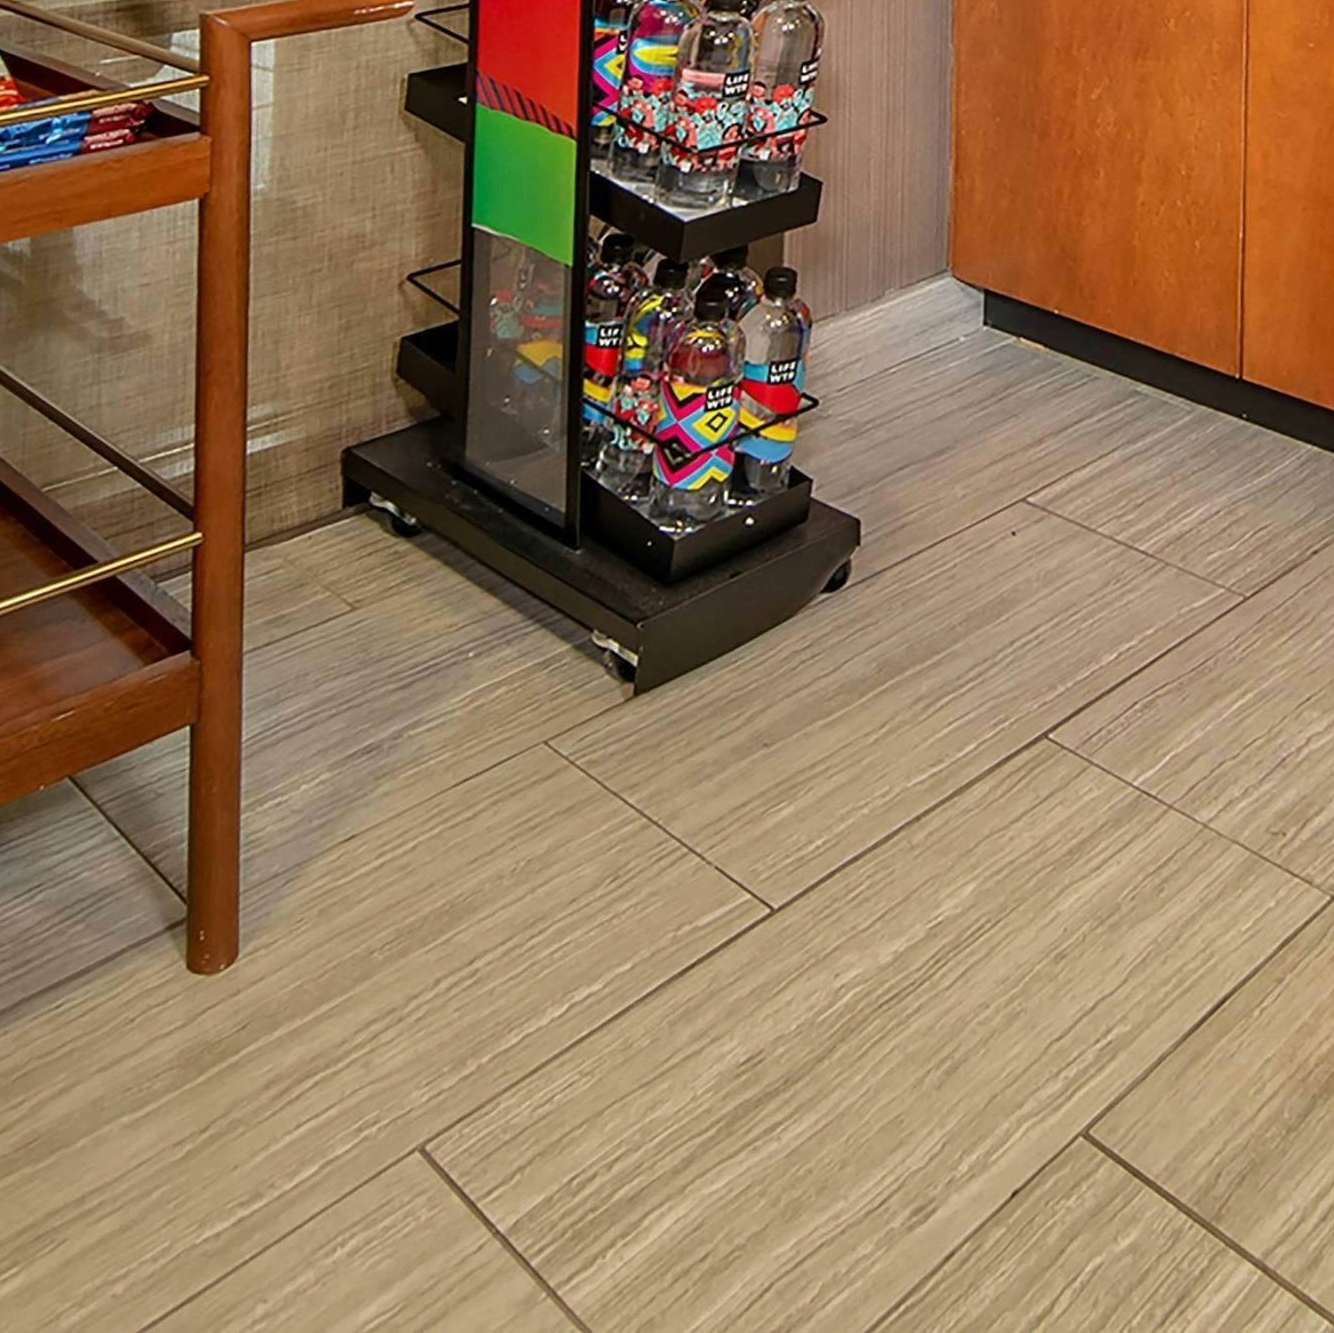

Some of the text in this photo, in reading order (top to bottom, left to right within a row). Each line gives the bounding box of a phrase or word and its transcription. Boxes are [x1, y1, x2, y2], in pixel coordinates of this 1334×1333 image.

[725, 73, 749, 87] LIFE
[771, 361, 796, 373] LIFE
[707, 386, 733, 401] LIFE
